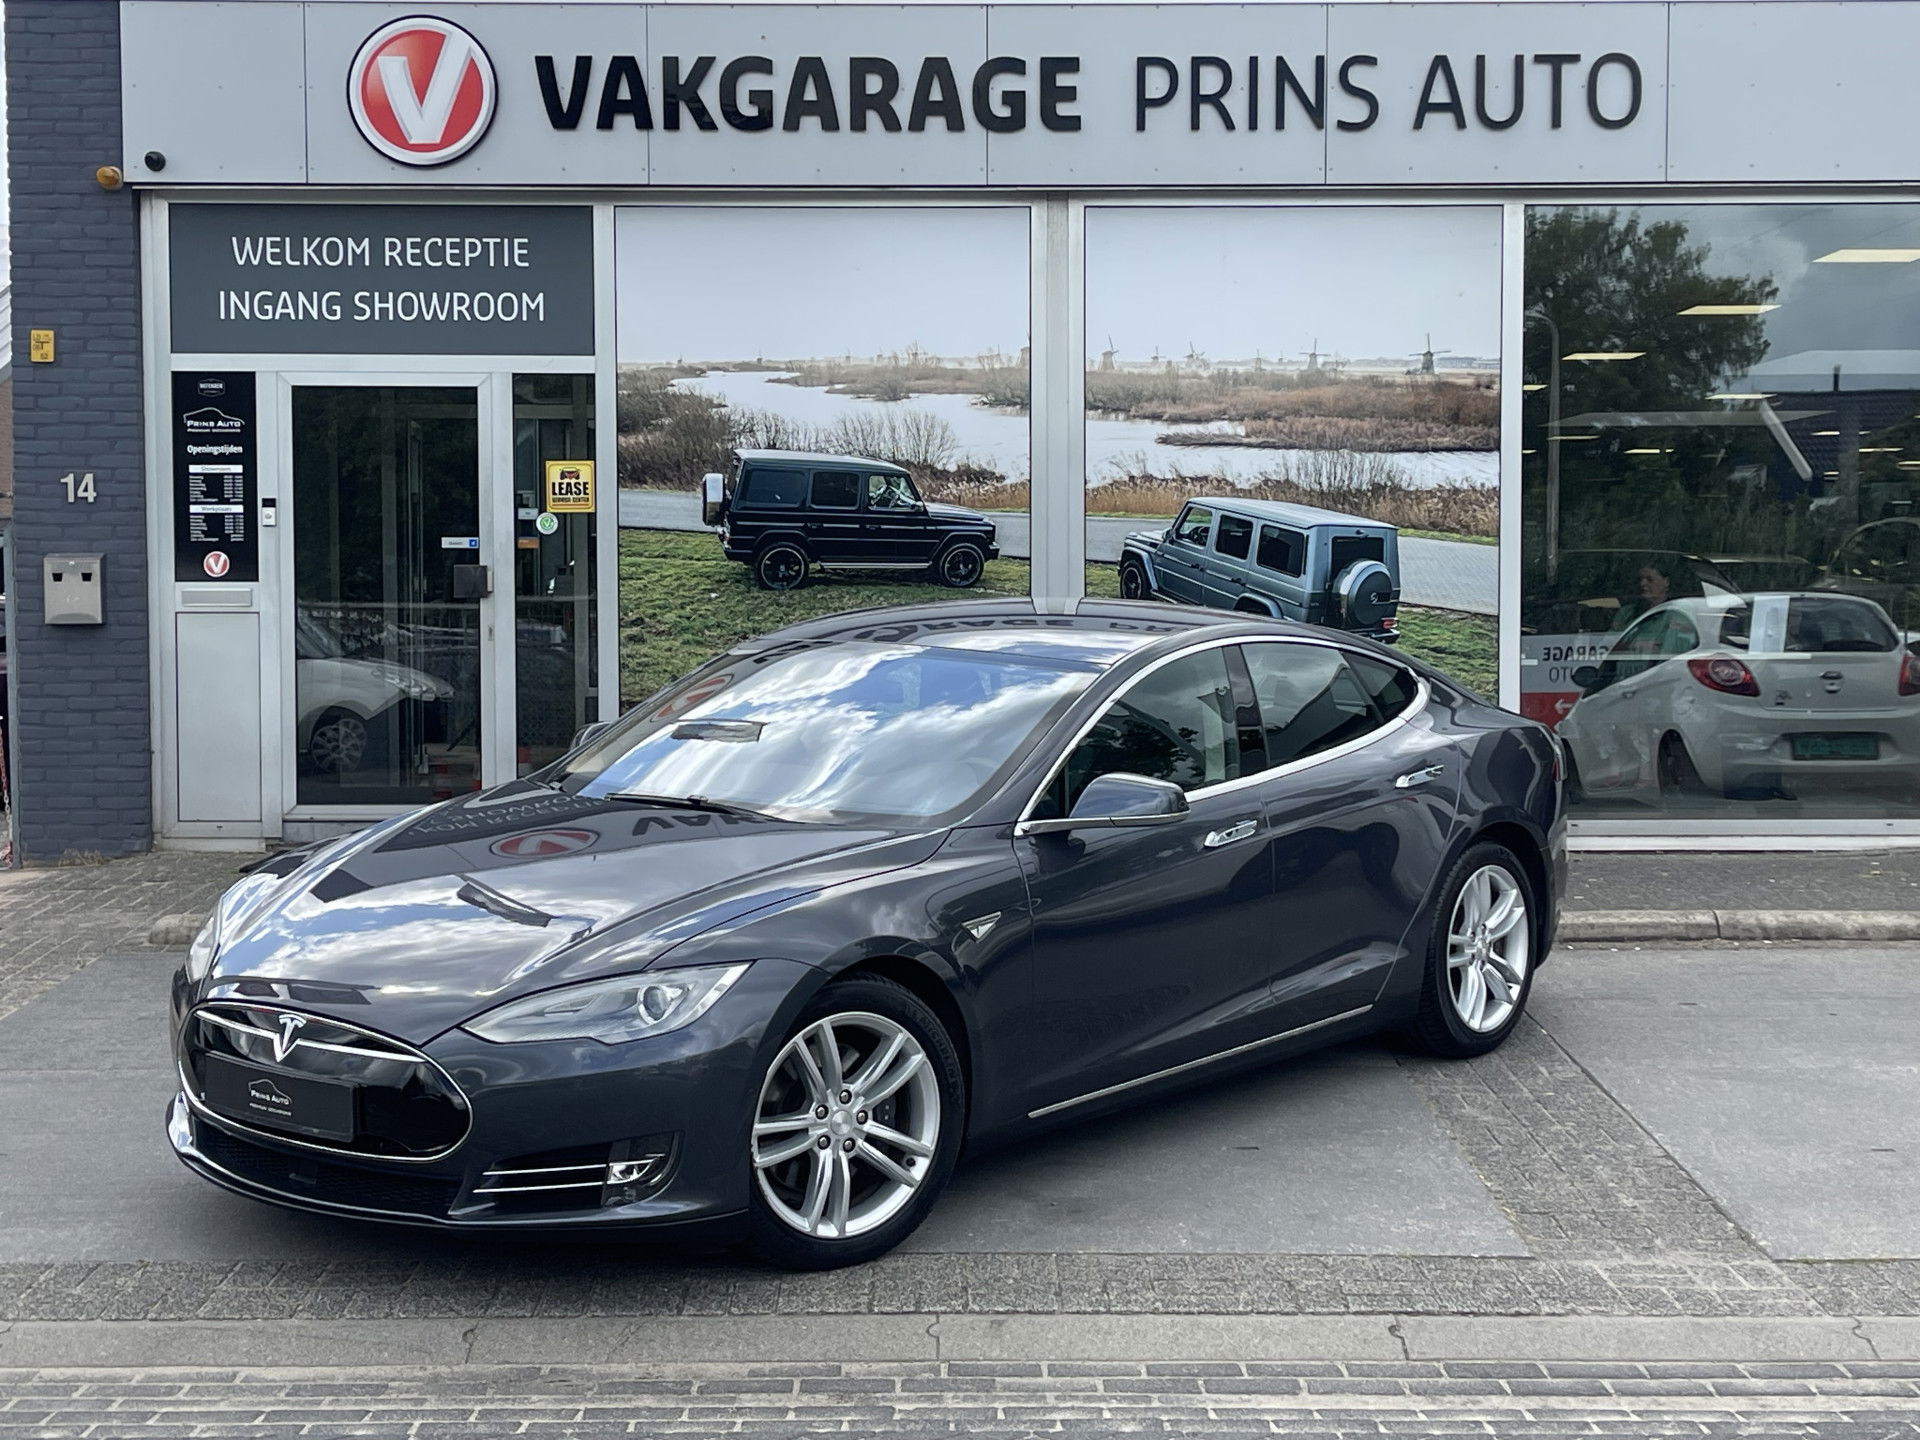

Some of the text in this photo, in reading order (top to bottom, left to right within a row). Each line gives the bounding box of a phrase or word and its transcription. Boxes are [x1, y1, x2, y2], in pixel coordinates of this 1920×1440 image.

[535, 53, 1642, 133] VAKGARAGE PRINS AUTO
[231, 236, 530, 267] WELKOM RECEPTIE
[219, 290, 544, 322] INGANG SHOWROOM
[187, 444, 243, 456] Openingstijden
[60, 473, 97, 503] 14
[551, 481, 590, 496] LEASE
